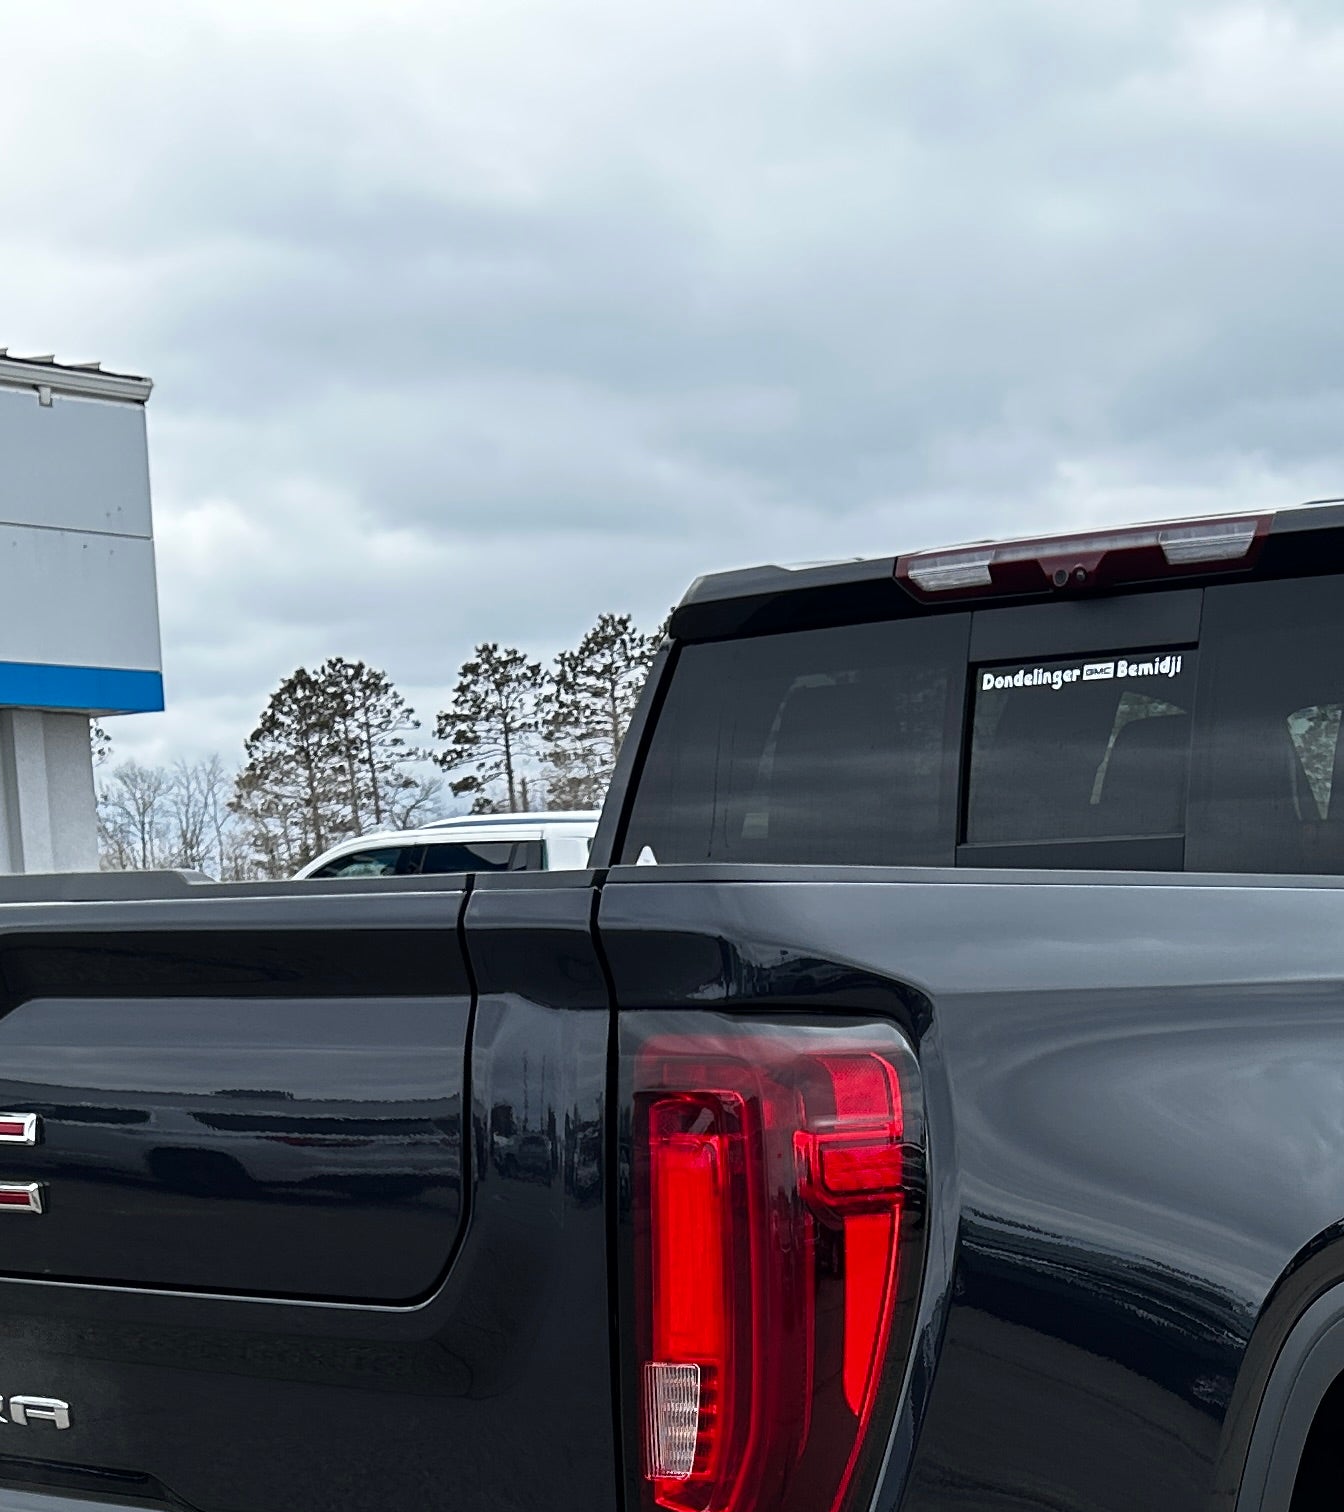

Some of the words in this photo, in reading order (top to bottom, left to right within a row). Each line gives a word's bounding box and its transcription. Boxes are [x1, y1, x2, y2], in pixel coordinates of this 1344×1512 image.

[982, 668, 1081, 690] Dondelinger
[1085, 666, 1113, 676] GMC
[1116, 656, 1182, 678] Bemidji
